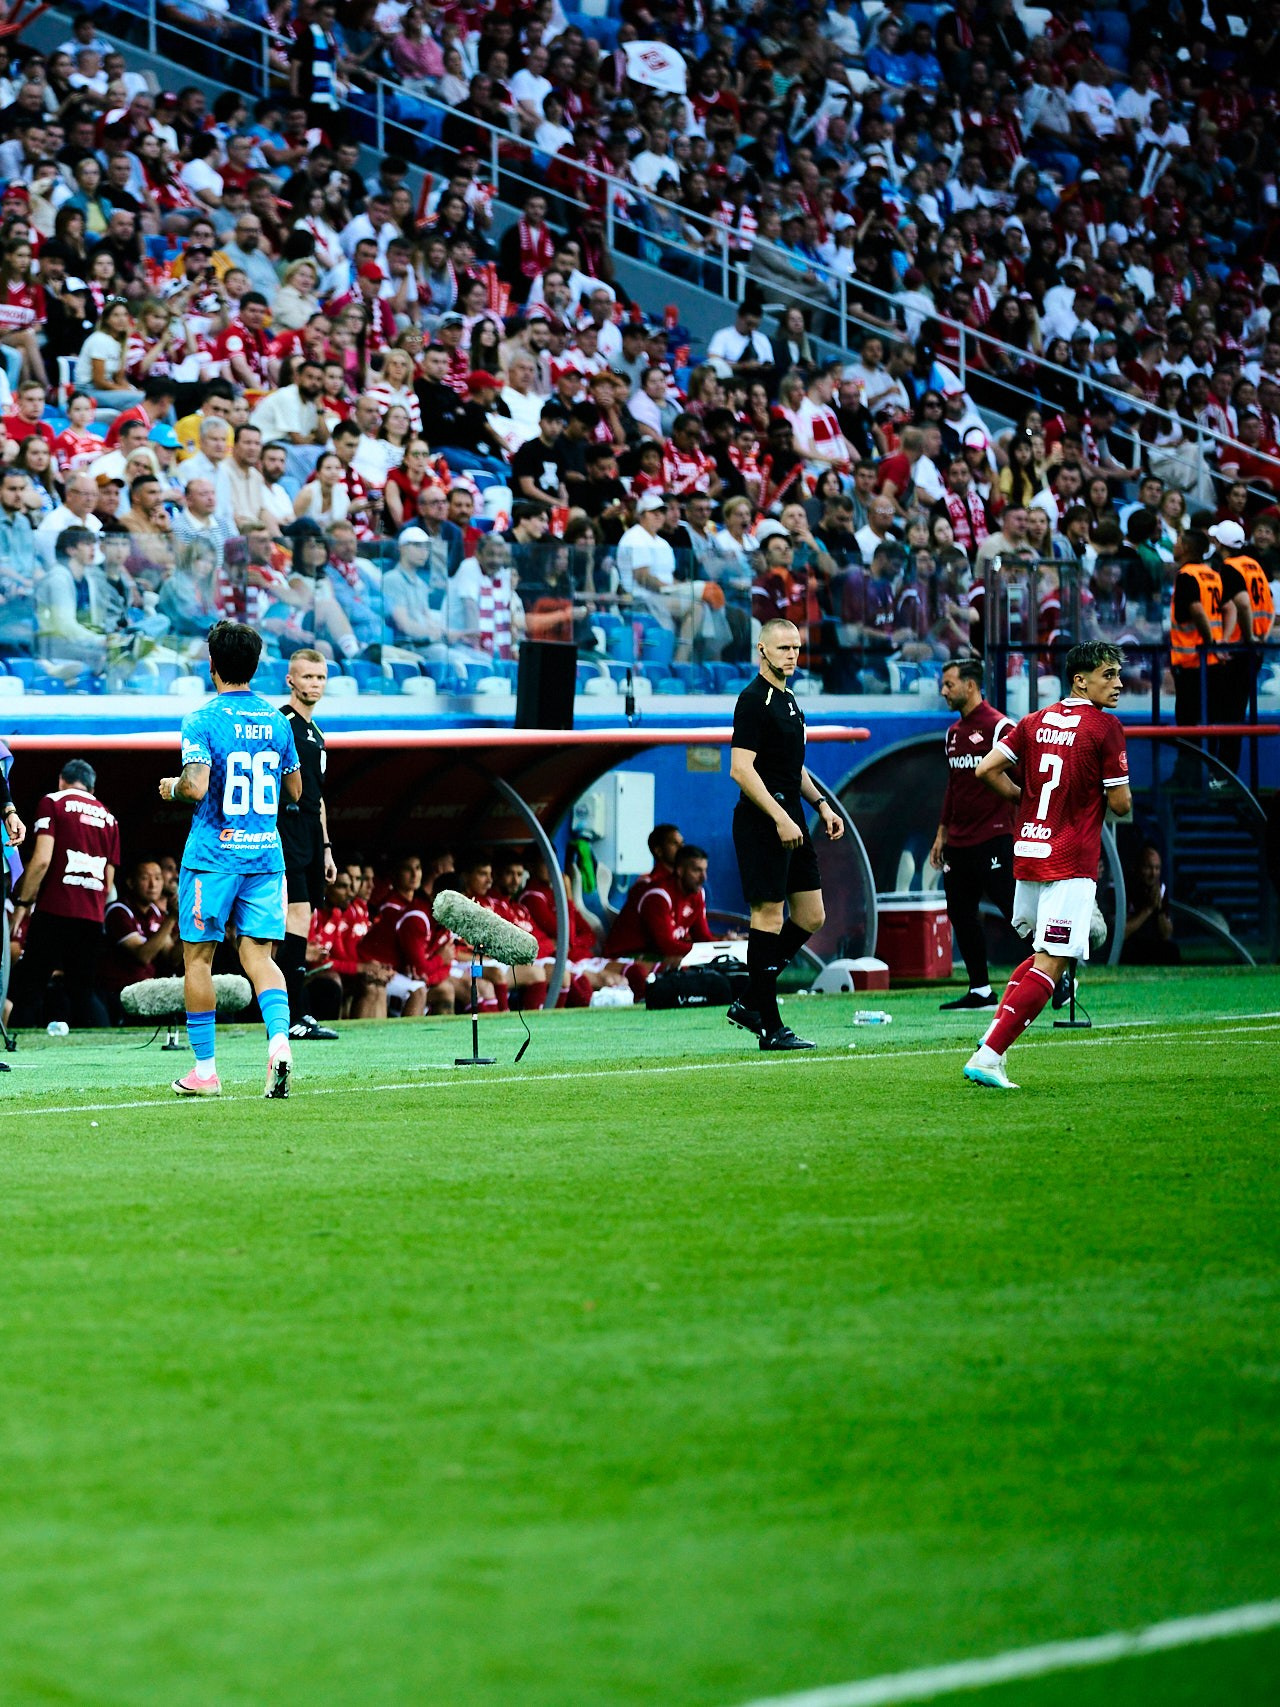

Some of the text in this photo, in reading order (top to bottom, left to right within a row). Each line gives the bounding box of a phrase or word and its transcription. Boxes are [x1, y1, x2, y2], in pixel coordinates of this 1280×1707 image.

[1036, 727, 1076, 746] СОЛАРИ
[223, 751, 280, 815] 66
[1036, 753, 1063, 820] 7
